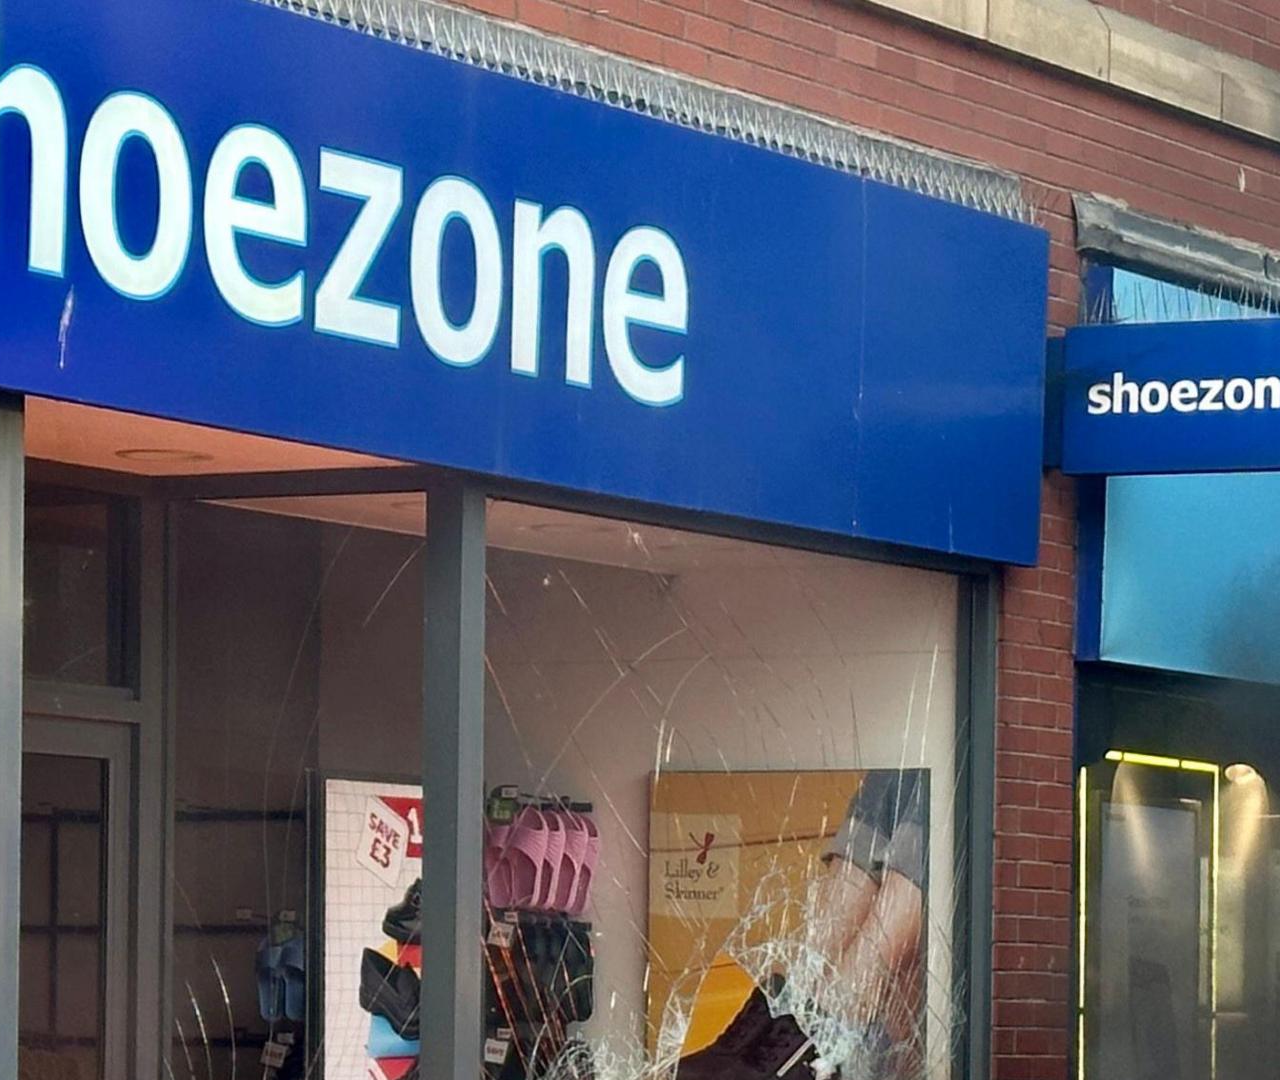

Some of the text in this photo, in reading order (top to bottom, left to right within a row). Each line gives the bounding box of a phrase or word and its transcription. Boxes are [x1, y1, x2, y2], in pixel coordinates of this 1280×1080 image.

[368, 811, 401, 850] SAVE
[664, 856, 720, 884] Lilley &
